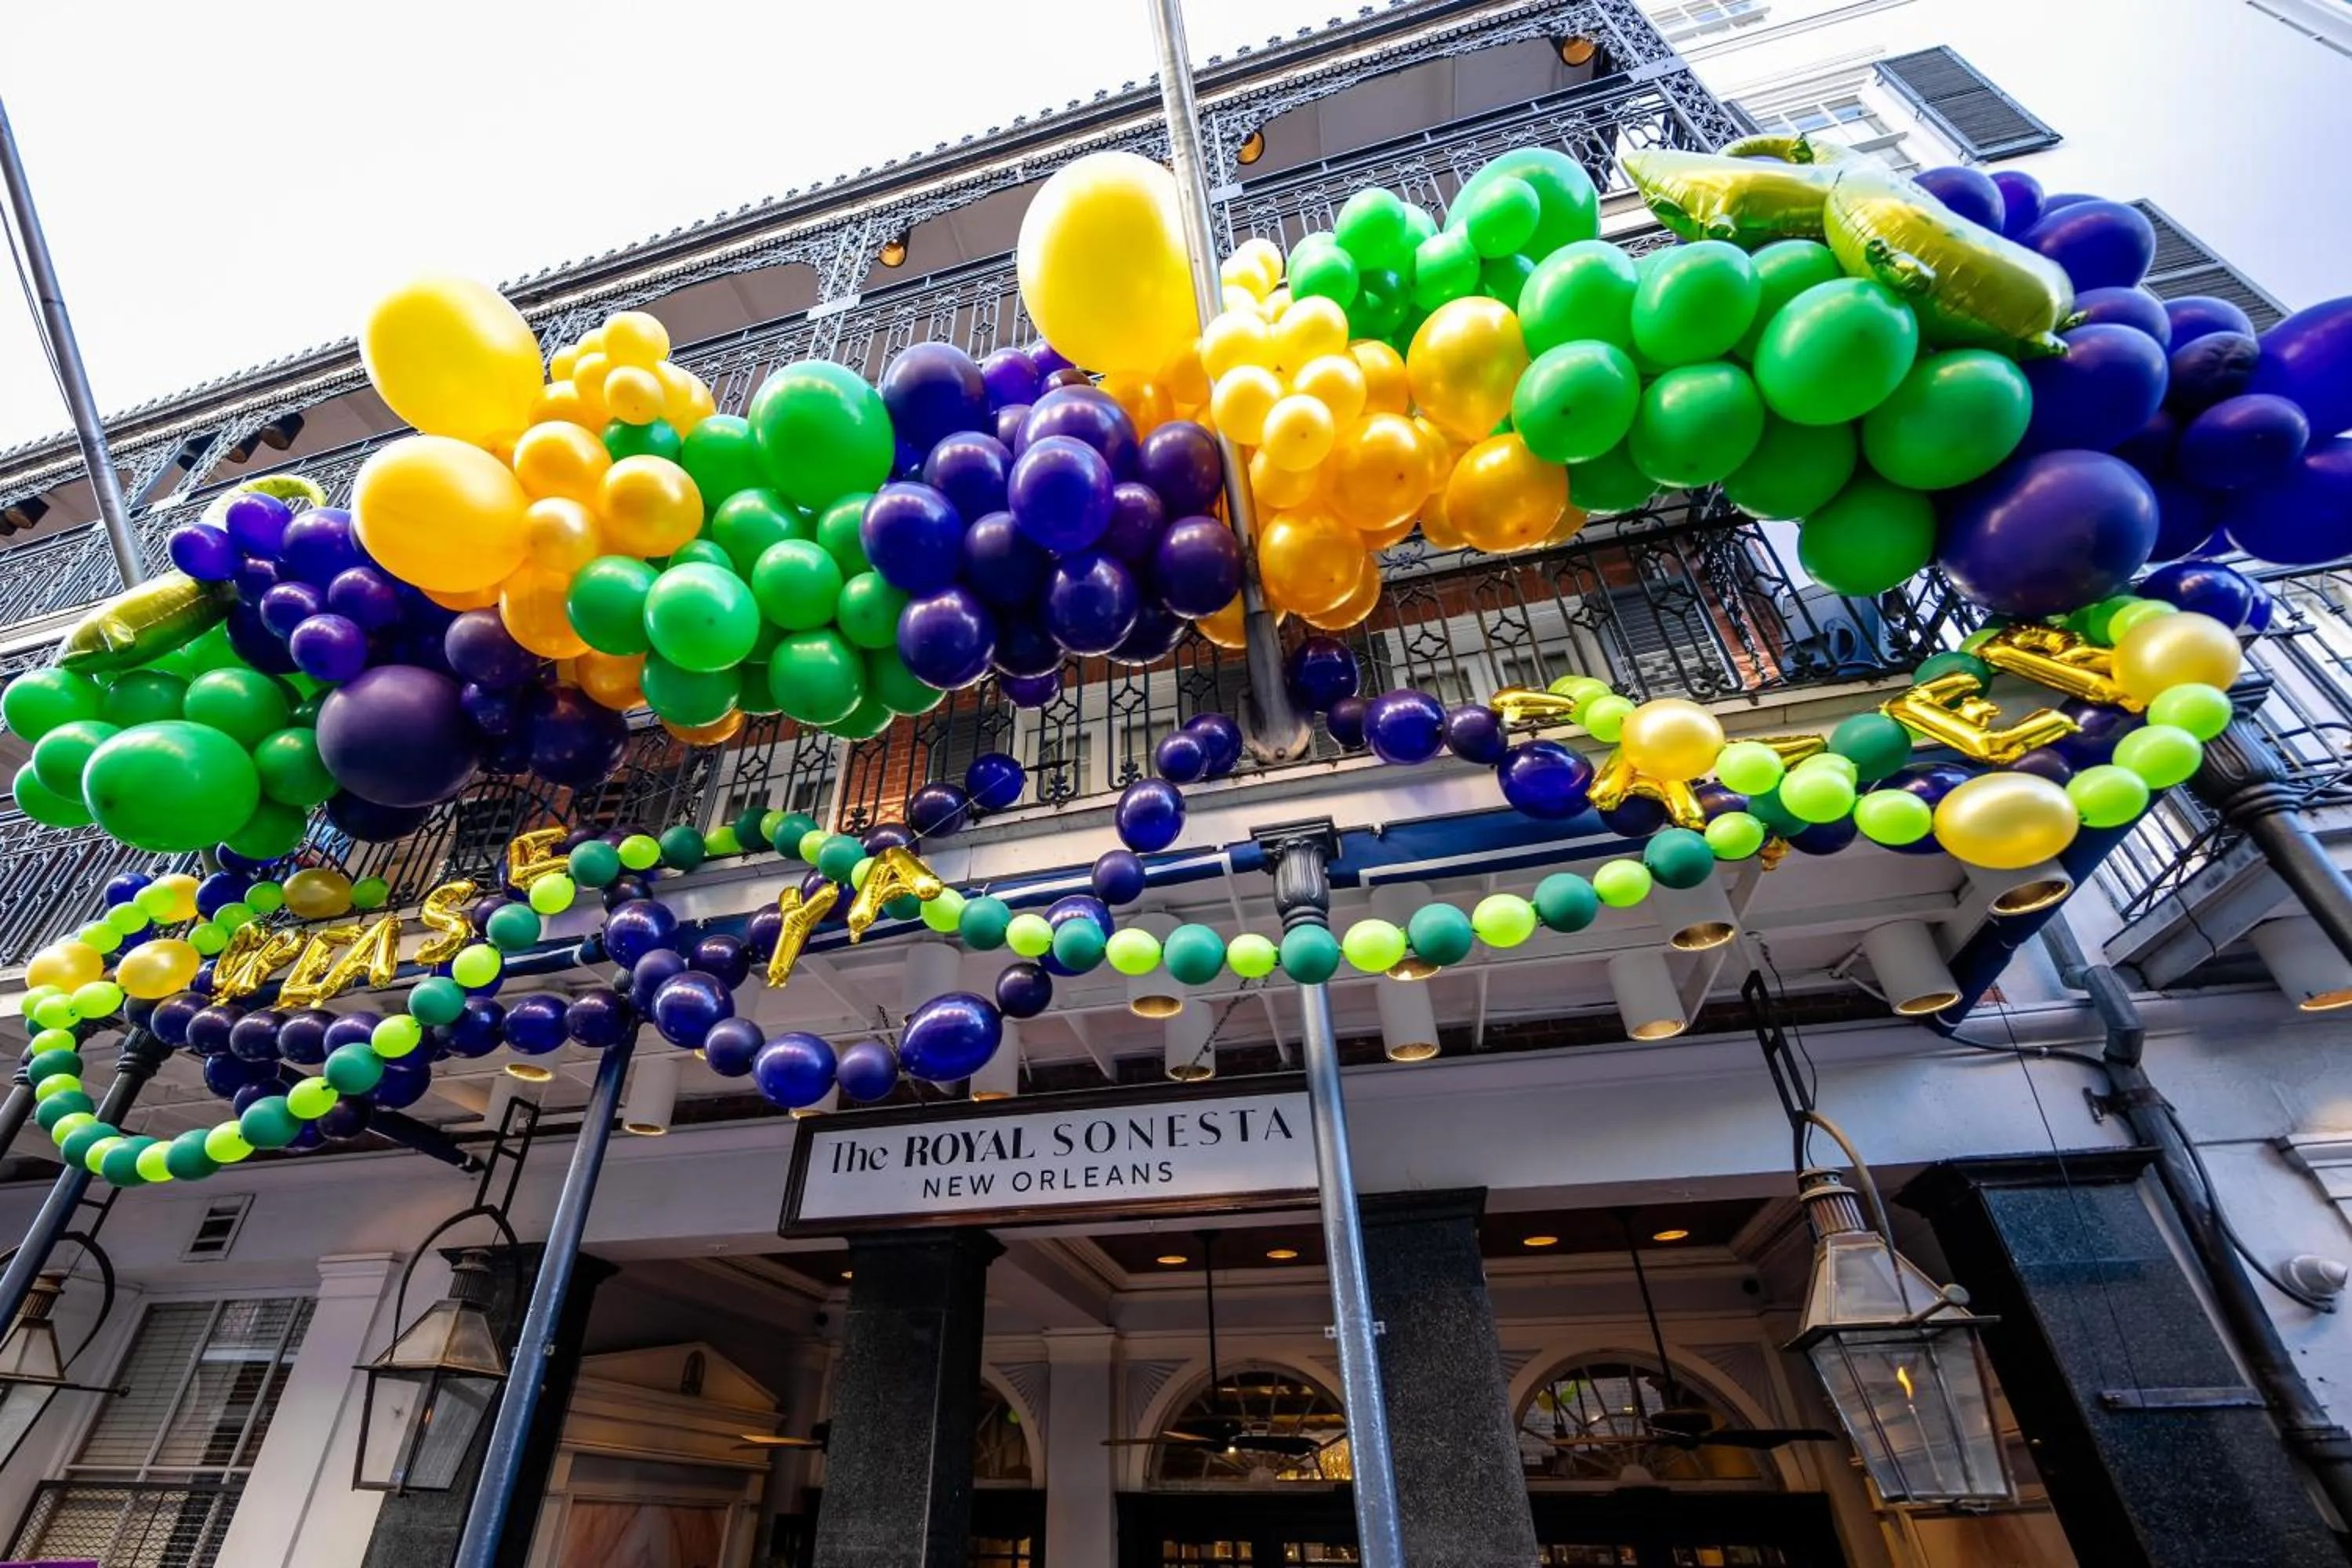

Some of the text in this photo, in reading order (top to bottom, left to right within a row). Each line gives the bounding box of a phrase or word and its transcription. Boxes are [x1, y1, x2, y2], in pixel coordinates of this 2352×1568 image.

[767, 845, 944, 988] YA
[828, 1105, 1294, 1174] The ROYAL SONESTA
[923, 1160, 1174, 1199] NEW ORLEANS
